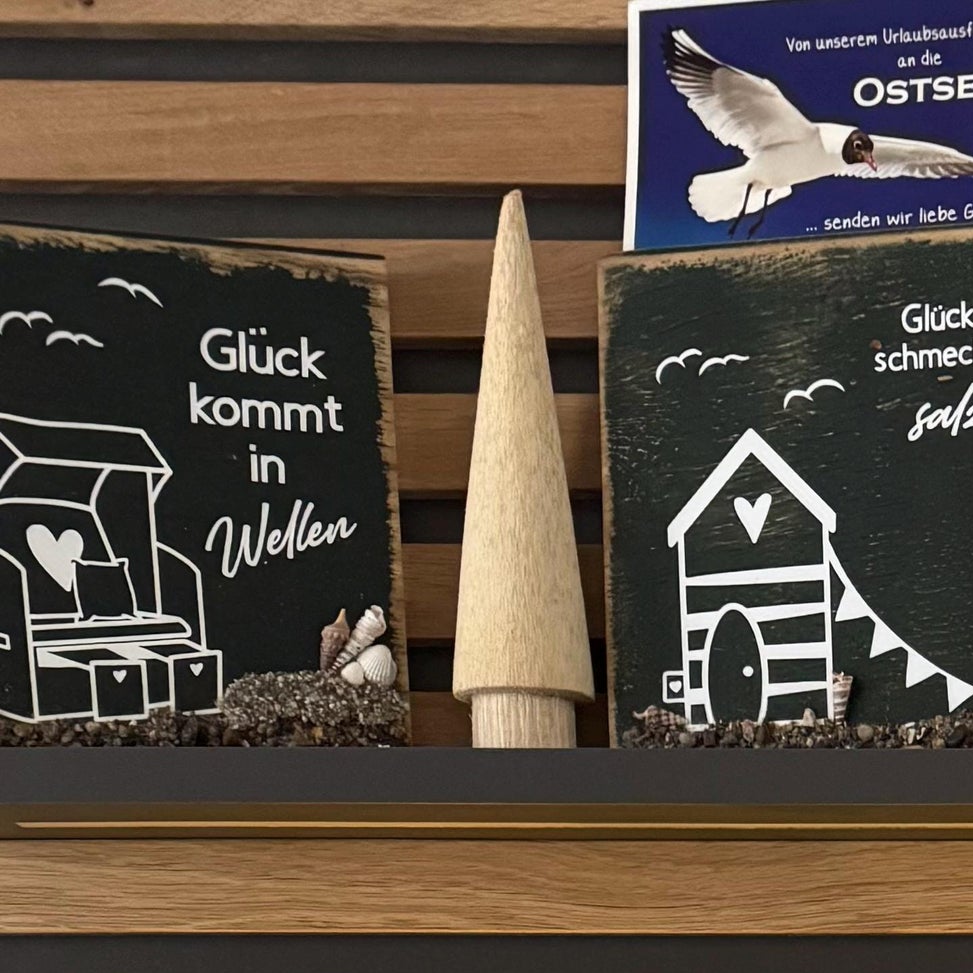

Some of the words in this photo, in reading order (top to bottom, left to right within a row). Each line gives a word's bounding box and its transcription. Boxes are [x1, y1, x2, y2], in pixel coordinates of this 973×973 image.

[786, 36, 811, 53] Von
[816, 34, 878, 50] unserem
[897, 55, 916, 68] an
[921, 49, 942, 66] die
[824, 211, 880, 231] senden
[886, 211, 913, 226] wir
[919, 205, 958, 224] liebe
[200, 327, 328, 380] Glück
[189, 381, 344, 434] kommt
[249, 444, 286, 485] in
[204, 499, 358, 578] Wellen
